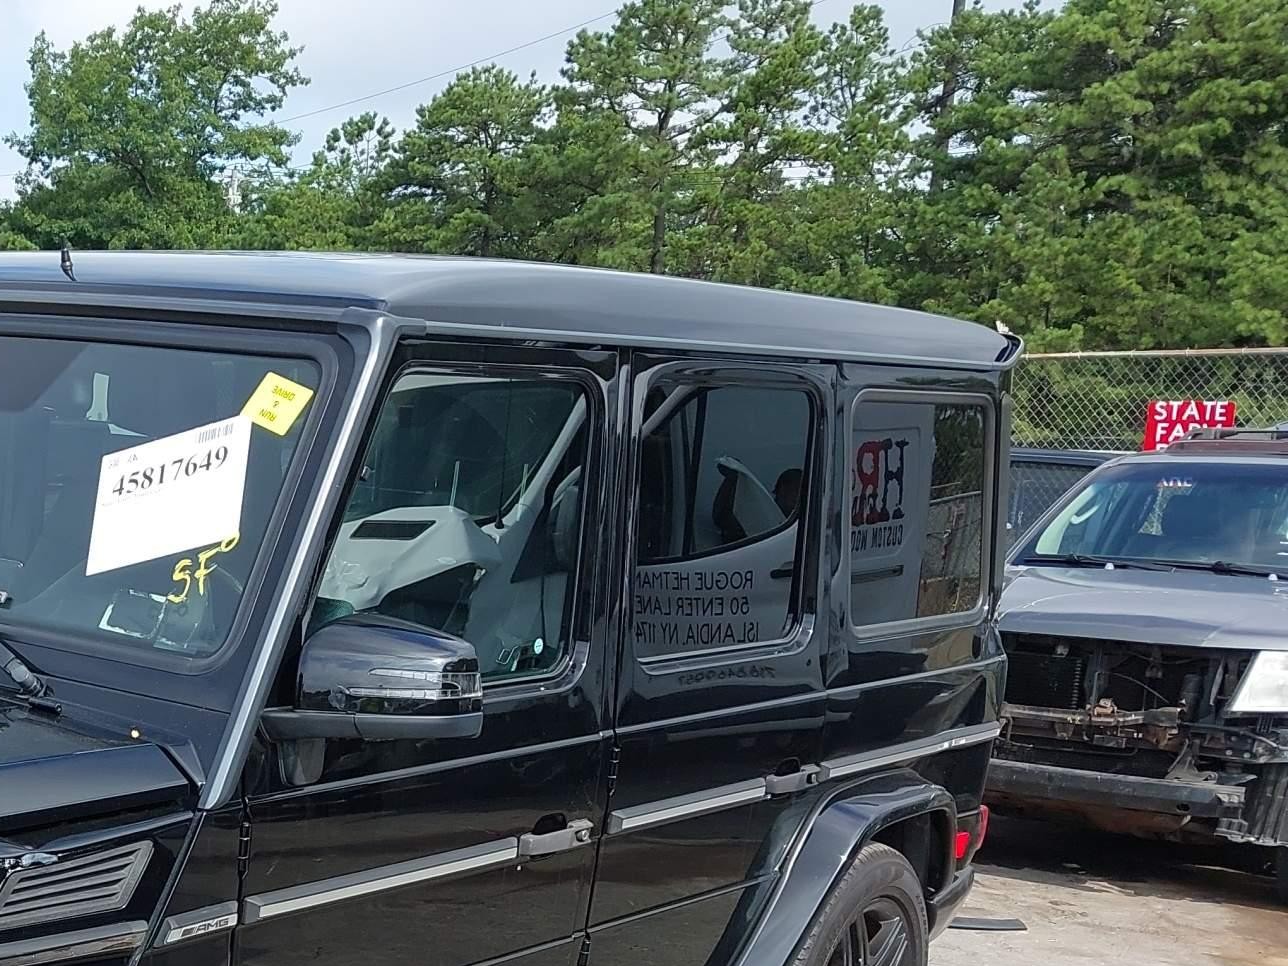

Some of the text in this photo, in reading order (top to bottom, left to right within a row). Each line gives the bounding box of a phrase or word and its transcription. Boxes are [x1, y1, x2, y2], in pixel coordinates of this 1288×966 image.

[272, 385, 295, 401] DRIVE
[1154, 400, 1228, 421] STATE
[112, 445, 228, 496] 45817649
[197, 918, 229, 932] AMG
